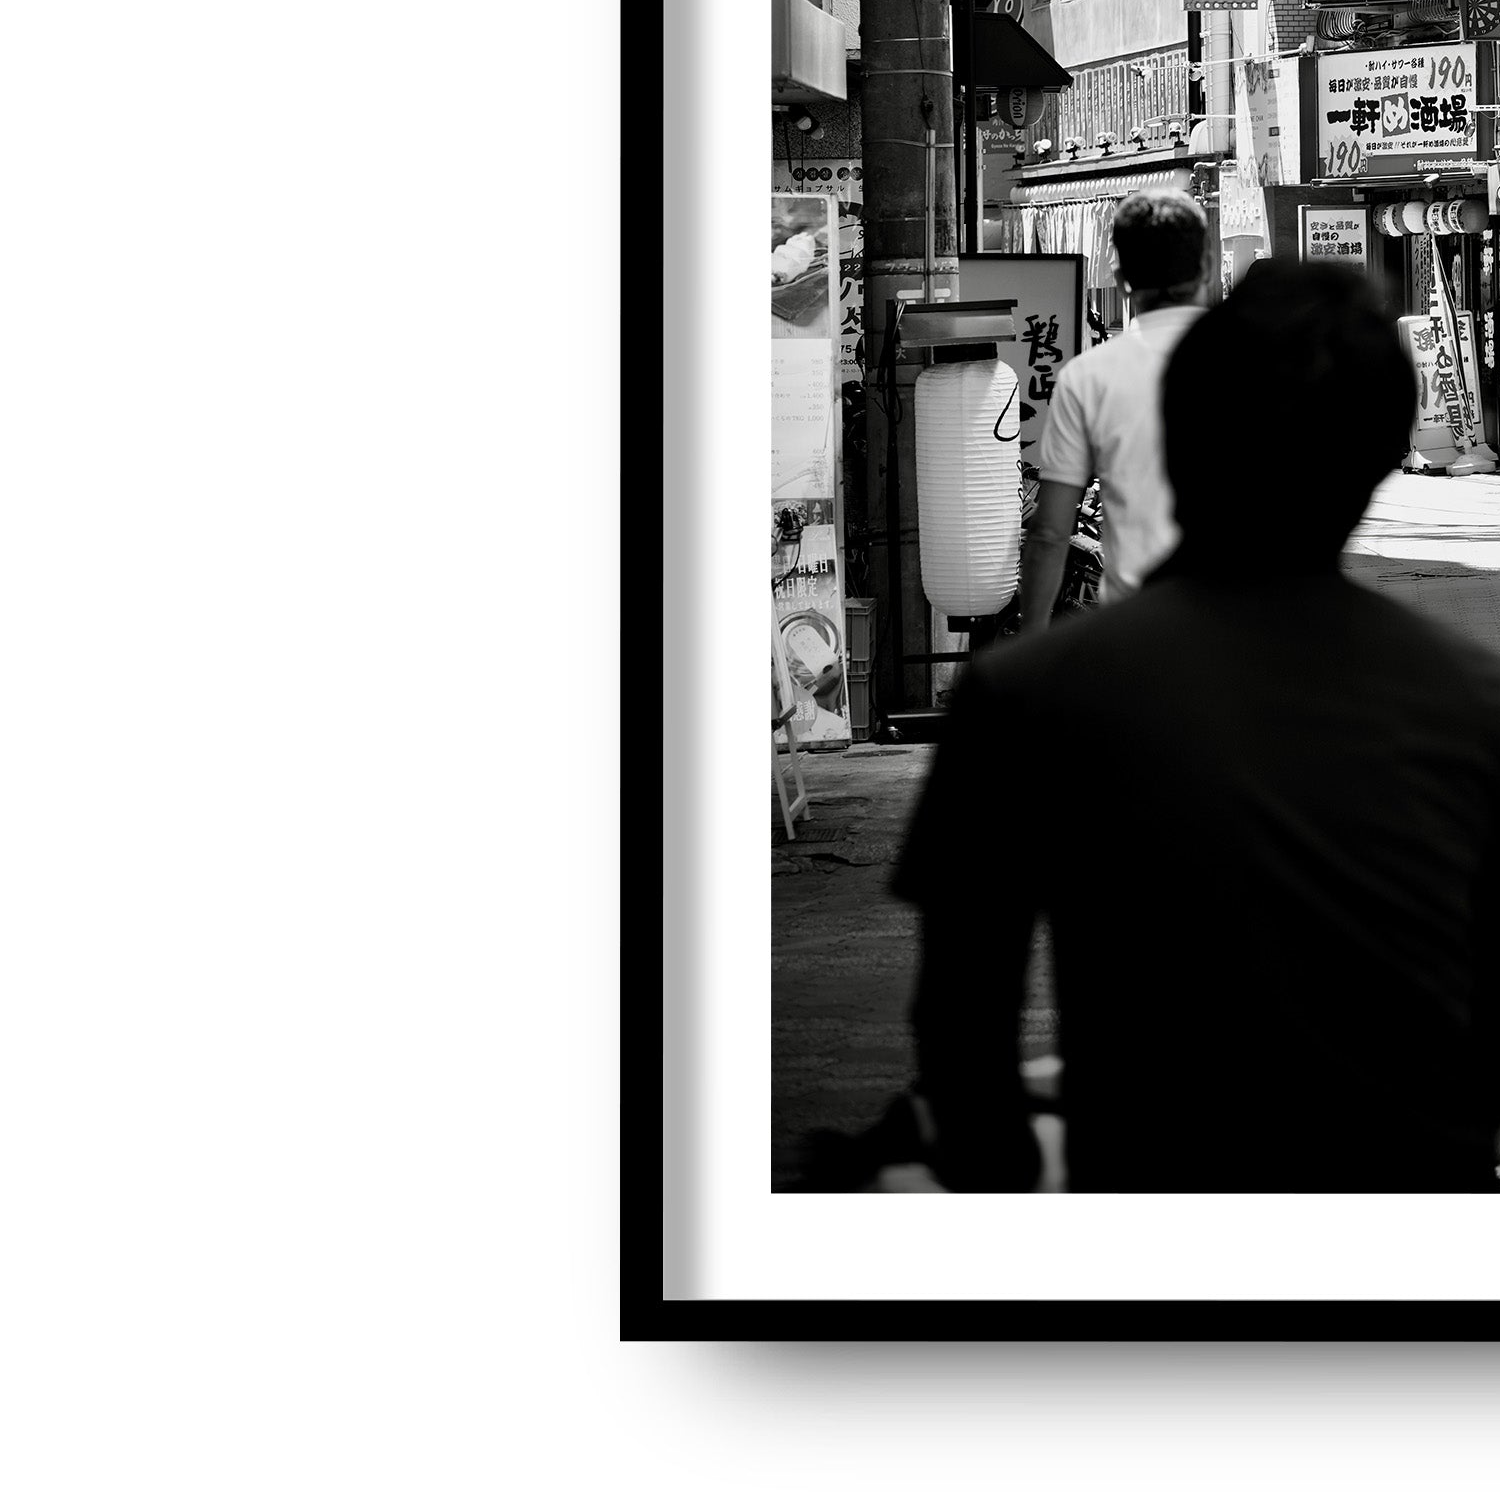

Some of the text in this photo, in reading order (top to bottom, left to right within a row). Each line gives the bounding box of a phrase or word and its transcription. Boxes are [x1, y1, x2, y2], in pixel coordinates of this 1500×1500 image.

[1428, 55, 1466, 90] 190
[1326, 92, 1468, 138] 一軒め酒場
